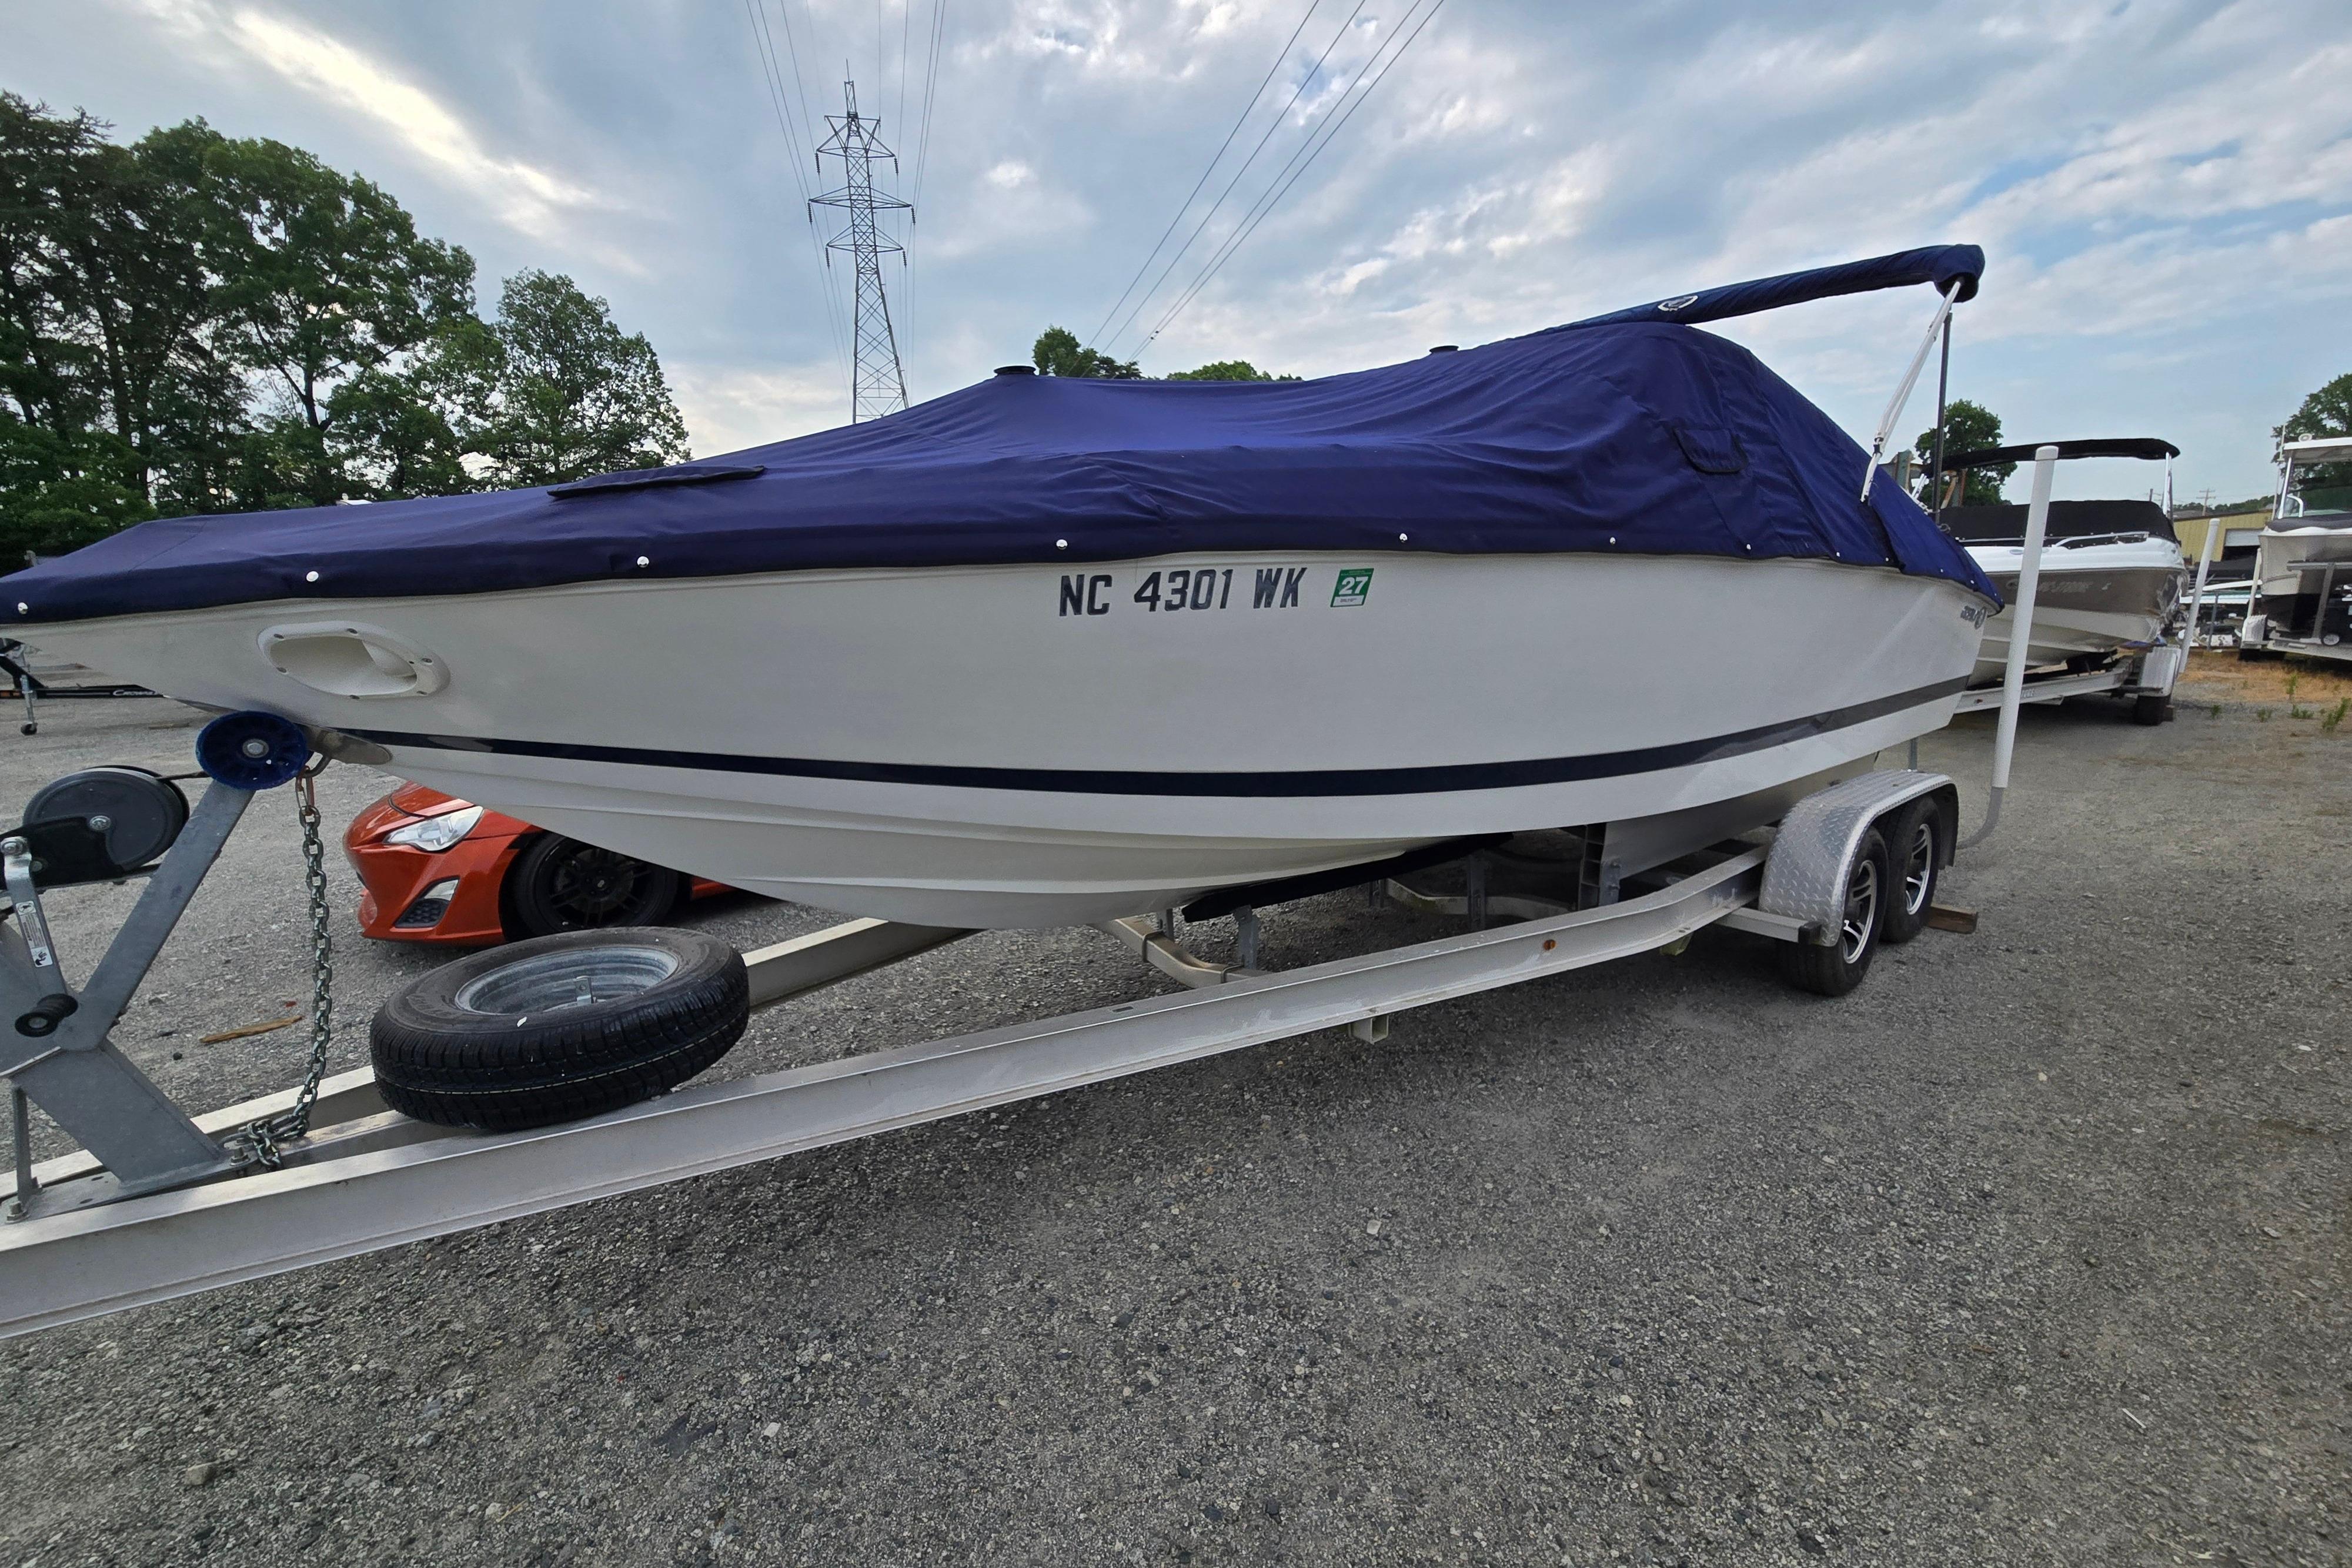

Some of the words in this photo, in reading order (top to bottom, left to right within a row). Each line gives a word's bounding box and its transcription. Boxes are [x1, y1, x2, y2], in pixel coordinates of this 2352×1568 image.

[1059, 574, 1112, 616] NC
[1134, 569, 1233, 612] 4301
[1253, 567, 1307, 609] WK
[1339, 576, 1368, 594] 27
